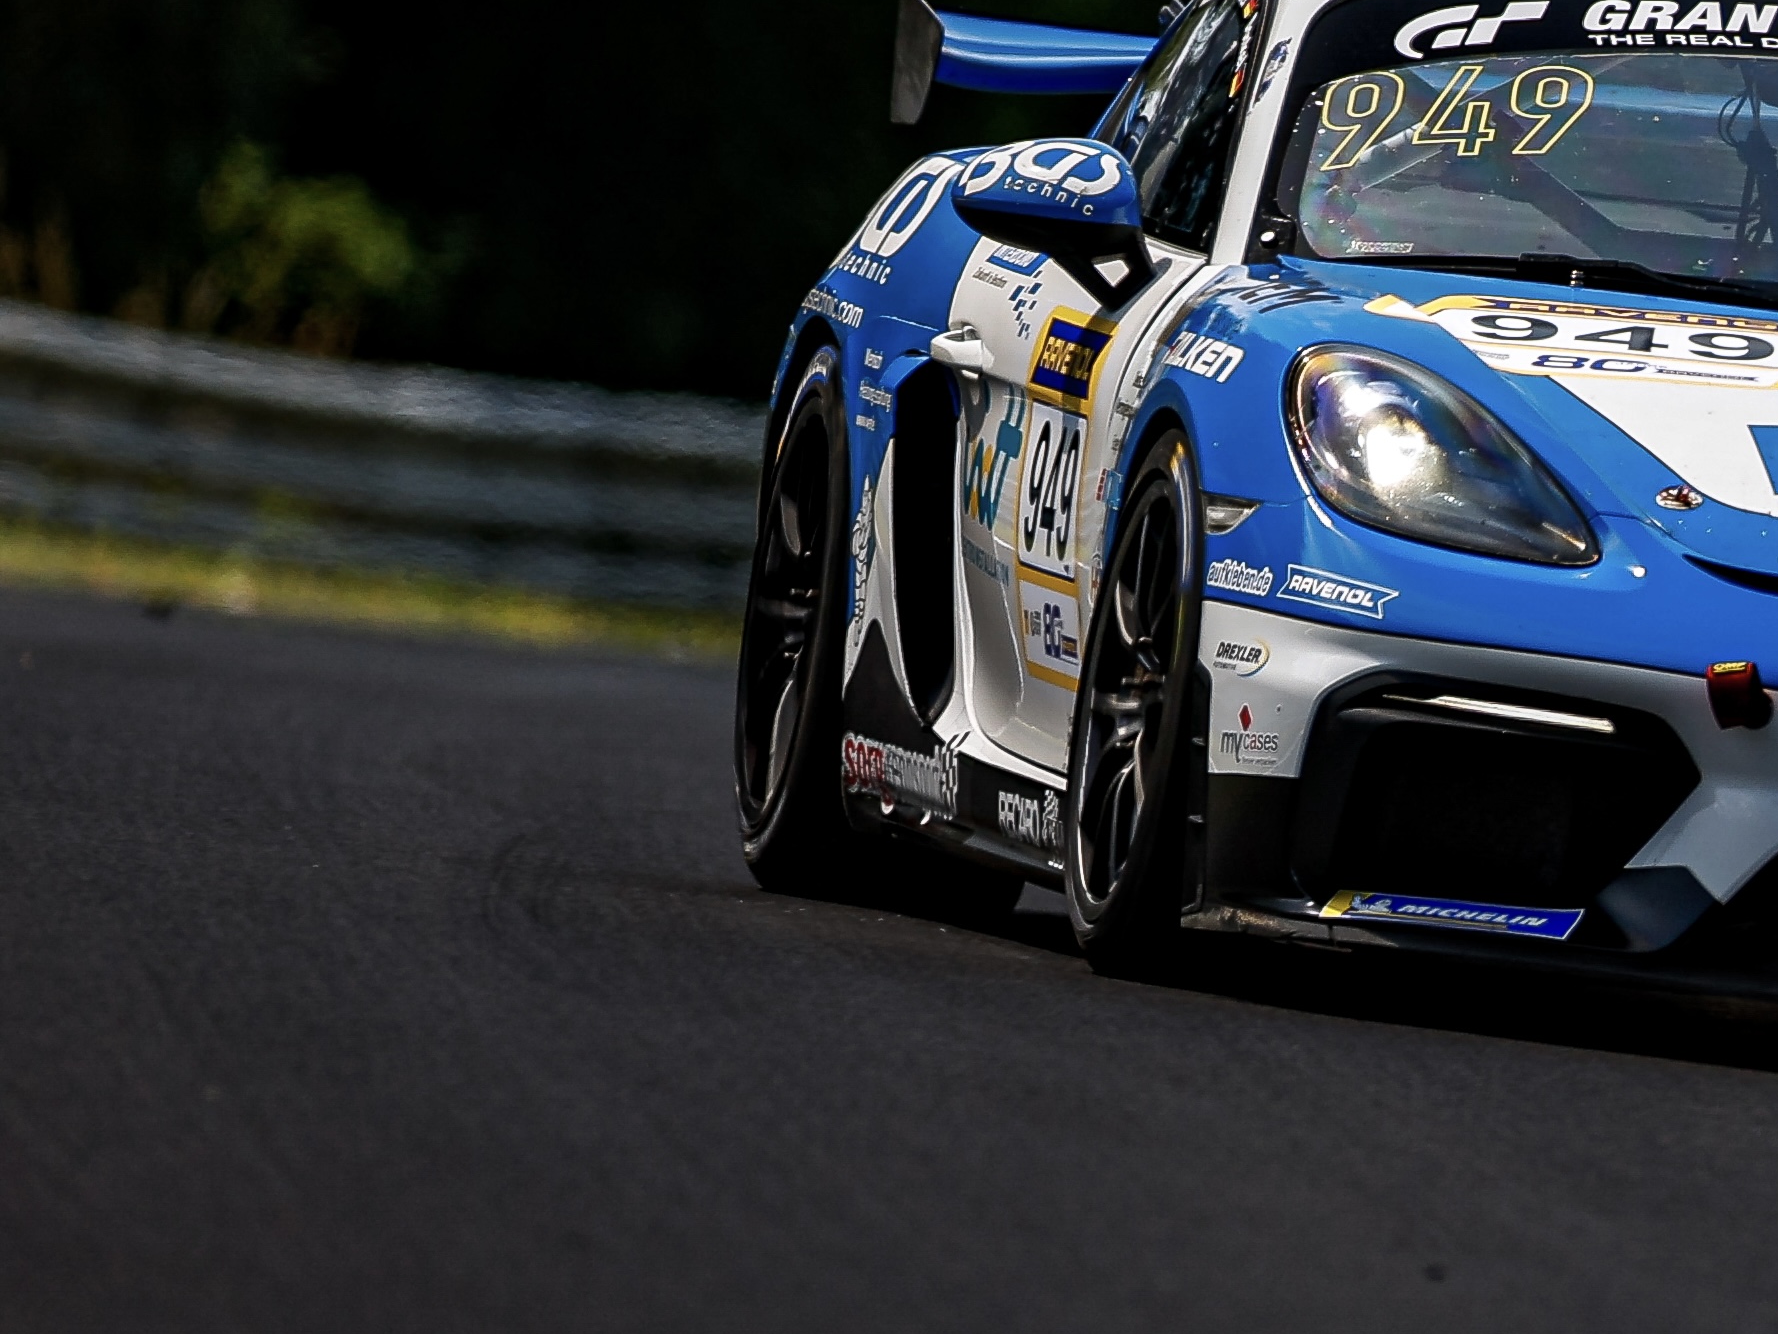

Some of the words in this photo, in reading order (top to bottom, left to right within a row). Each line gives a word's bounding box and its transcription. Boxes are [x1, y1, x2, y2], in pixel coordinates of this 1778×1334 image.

[1588, 33, 1655, 46] THE
[1666, 33, 1753, 48] REAL
[1320, 65, 1594, 171] 949
[958, 140, 1121, 196] BGS
[1003, 176, 1094, 215] technic
[1471, 315, 1774, 360] 949
[1040, 336, 1096, 380] RAVENOL
[1024, 420, 1081, 560] 949
[1207, 560, 1272, 596] aufkleben.de
[1288, 574, 1376, 608] RAVENOL
[1215, 641, 1262, 664] DREXLER
[1396, 904, 1549, 927] MICHELIN
